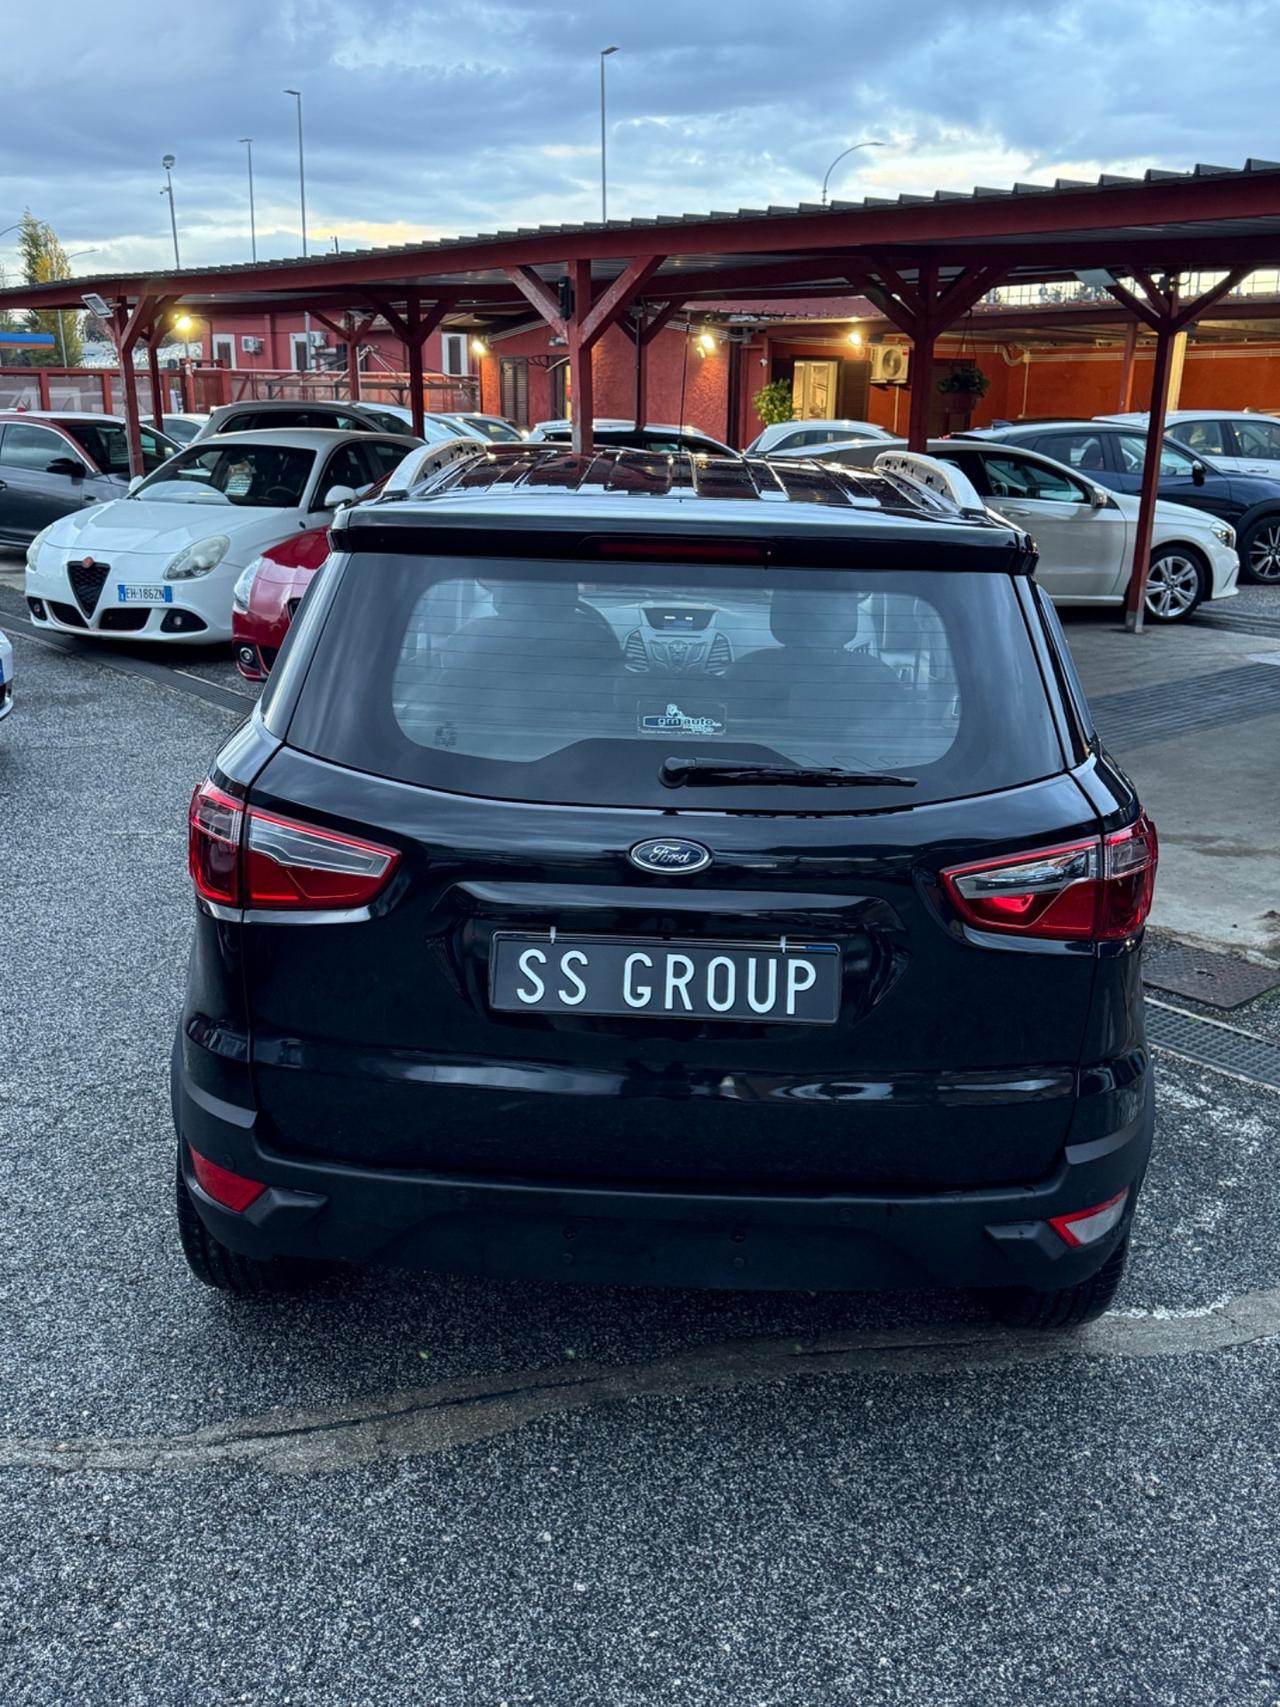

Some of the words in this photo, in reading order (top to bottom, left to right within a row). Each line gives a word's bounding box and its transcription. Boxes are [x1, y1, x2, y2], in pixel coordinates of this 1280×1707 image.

[648, 845, 691, 863] Ford
[516, 948, 589, 1006] SS
[622, 952, 817, 1015] GROUP
